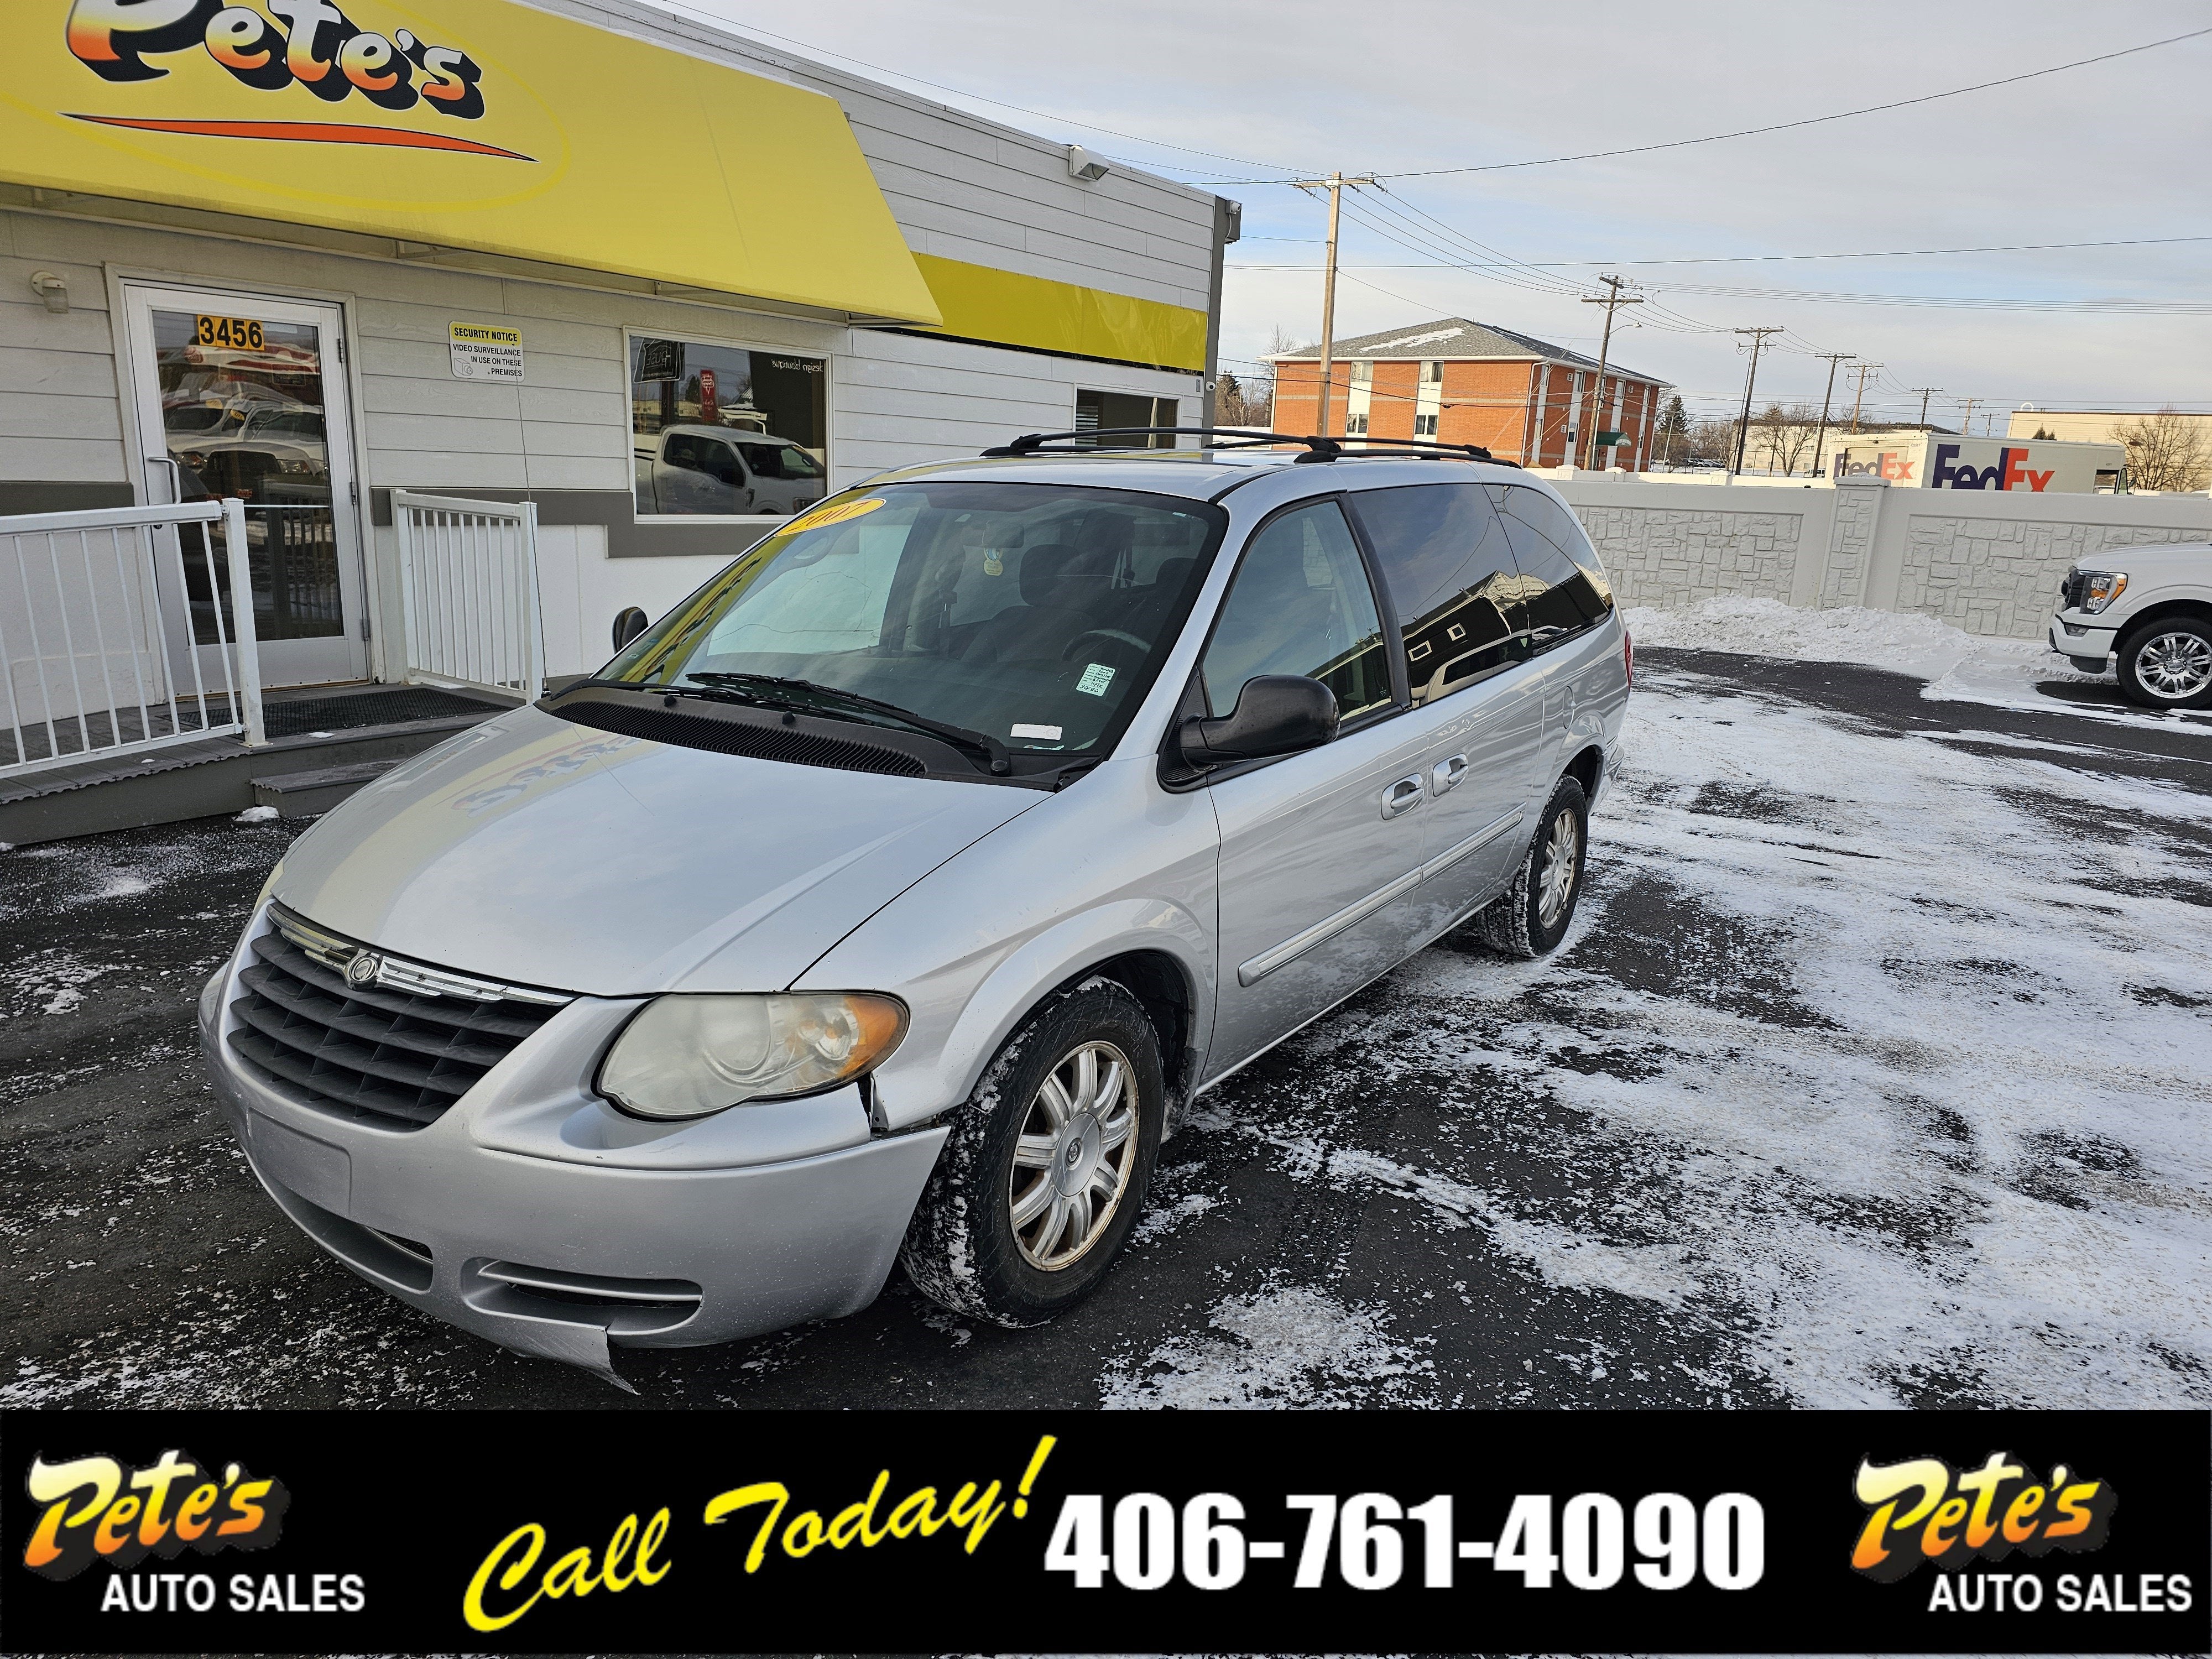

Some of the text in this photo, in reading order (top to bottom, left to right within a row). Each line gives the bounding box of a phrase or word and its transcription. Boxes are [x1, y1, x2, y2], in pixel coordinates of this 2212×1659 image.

[200, 317, 263, 348] 3456
[454, 327, 518, 342] SECURITY NOTICE
[453, 343, 521, 357] VIDEO SURVEILLANCE
[502, 358, 522, 367] THESE
[491, 368, 523, 377] PREMISES
[1833, 452, 1915, 480] FedEx
[785, 500, 872, 533] 2007
